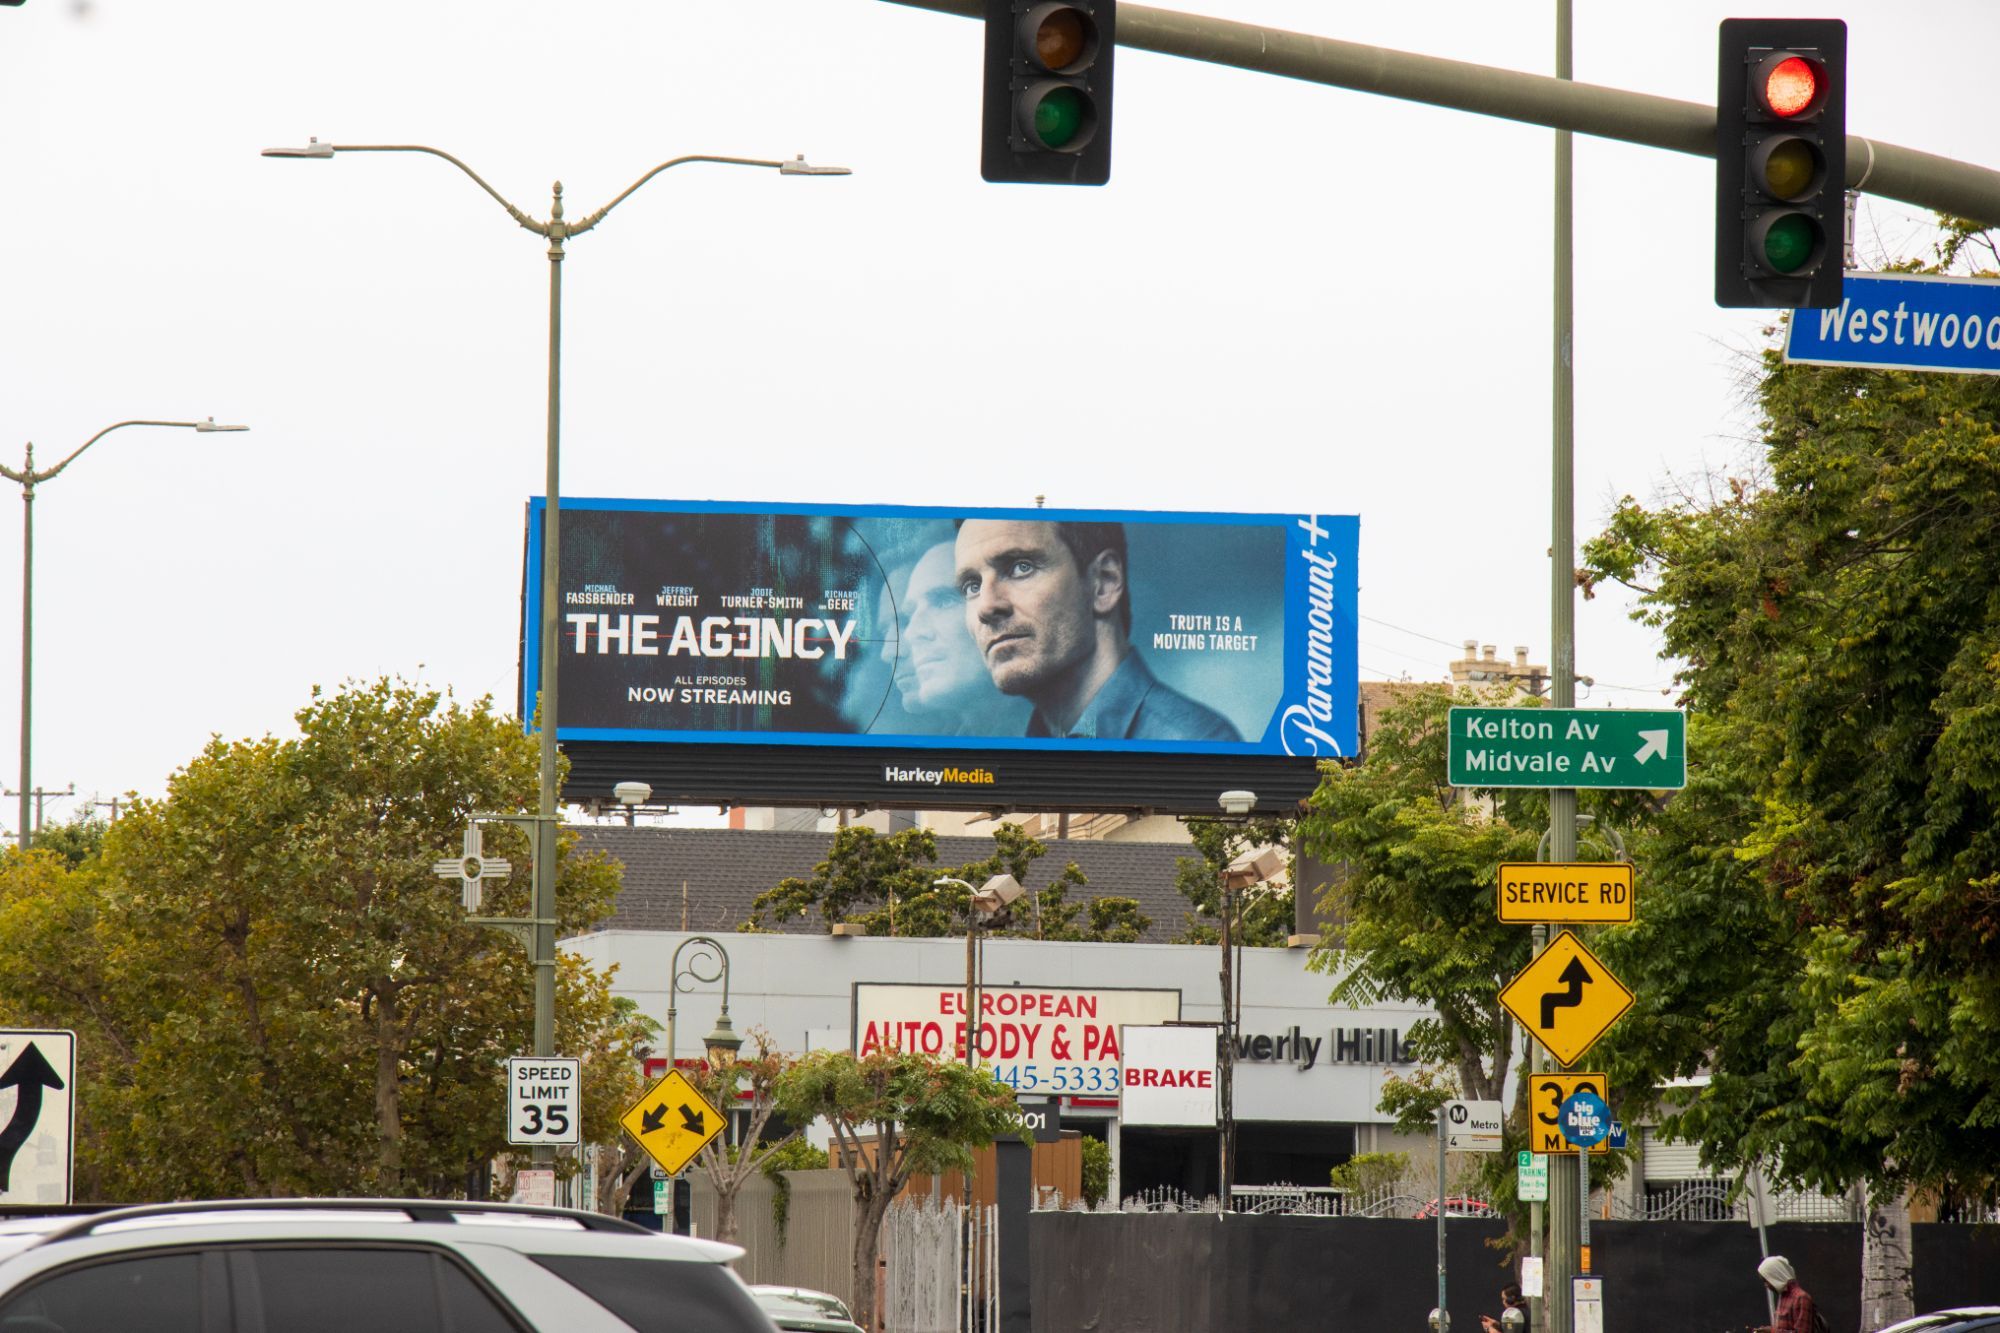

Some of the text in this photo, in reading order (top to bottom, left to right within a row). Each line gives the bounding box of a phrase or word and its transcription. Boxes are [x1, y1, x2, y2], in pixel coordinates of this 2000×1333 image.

[584, 584, 617, 593] MICHAEL
[661, 586, 693, 595] JEFFREY
[750, 588, 773, 597] JODIE
[824, 590, 858, 599] RICHARD
[566, 592, 634, 605] FASSBENDER
[656, 594, 699, 607] WRIGHT
[720, 596, 803, 609] TURNER-SMITH
[827, 599, 855, 610] GERE
[1169, 614, 1243, 632] TRUTH IS A
[566, 613, 660, 655] THE
[1281, 514, 1342, 757] Paramount+
[1153, 632, 1258, 651] MOVING TARGET
[674, 675, 747, 687] ALL EPISODES
[628, 687, 792, 706] NOW STREAMING
[1466, 716, 1600, 741] Kelton Av
[1465, 749, 1616, 774] Midvale Av
[1506, 881, 1627, 905] SERVICE RD
[940, 992, 1097, 1018] EUROPEAN
[861, 1020, 943, 1057] AUTO
[1051, 1024, 1072, 1060] &
[1084, 1024, 1119, 1061] PA
[1332, 1027, 1419, 1064] Hills
[518, 1067, 571, 1080] SPEED
[1125, 1068, 1212, 1088] BRAKE
[520, 1086, 570, 1099] LIMIT
[1574, 1101, 1593, 1115] big
[520, 1104, 569, 1135] 35
[1471, 1120, 1499, 1129] Metro
[1568, 1112, 1600, 1126] blue
[1607, 1123, 1623, 1137] Av
[1450, 1136, 1457, 1146] 4
[1521, 1154, 1528, 1165] 2
[1520, 1167, 1546, 1177] PARKING
